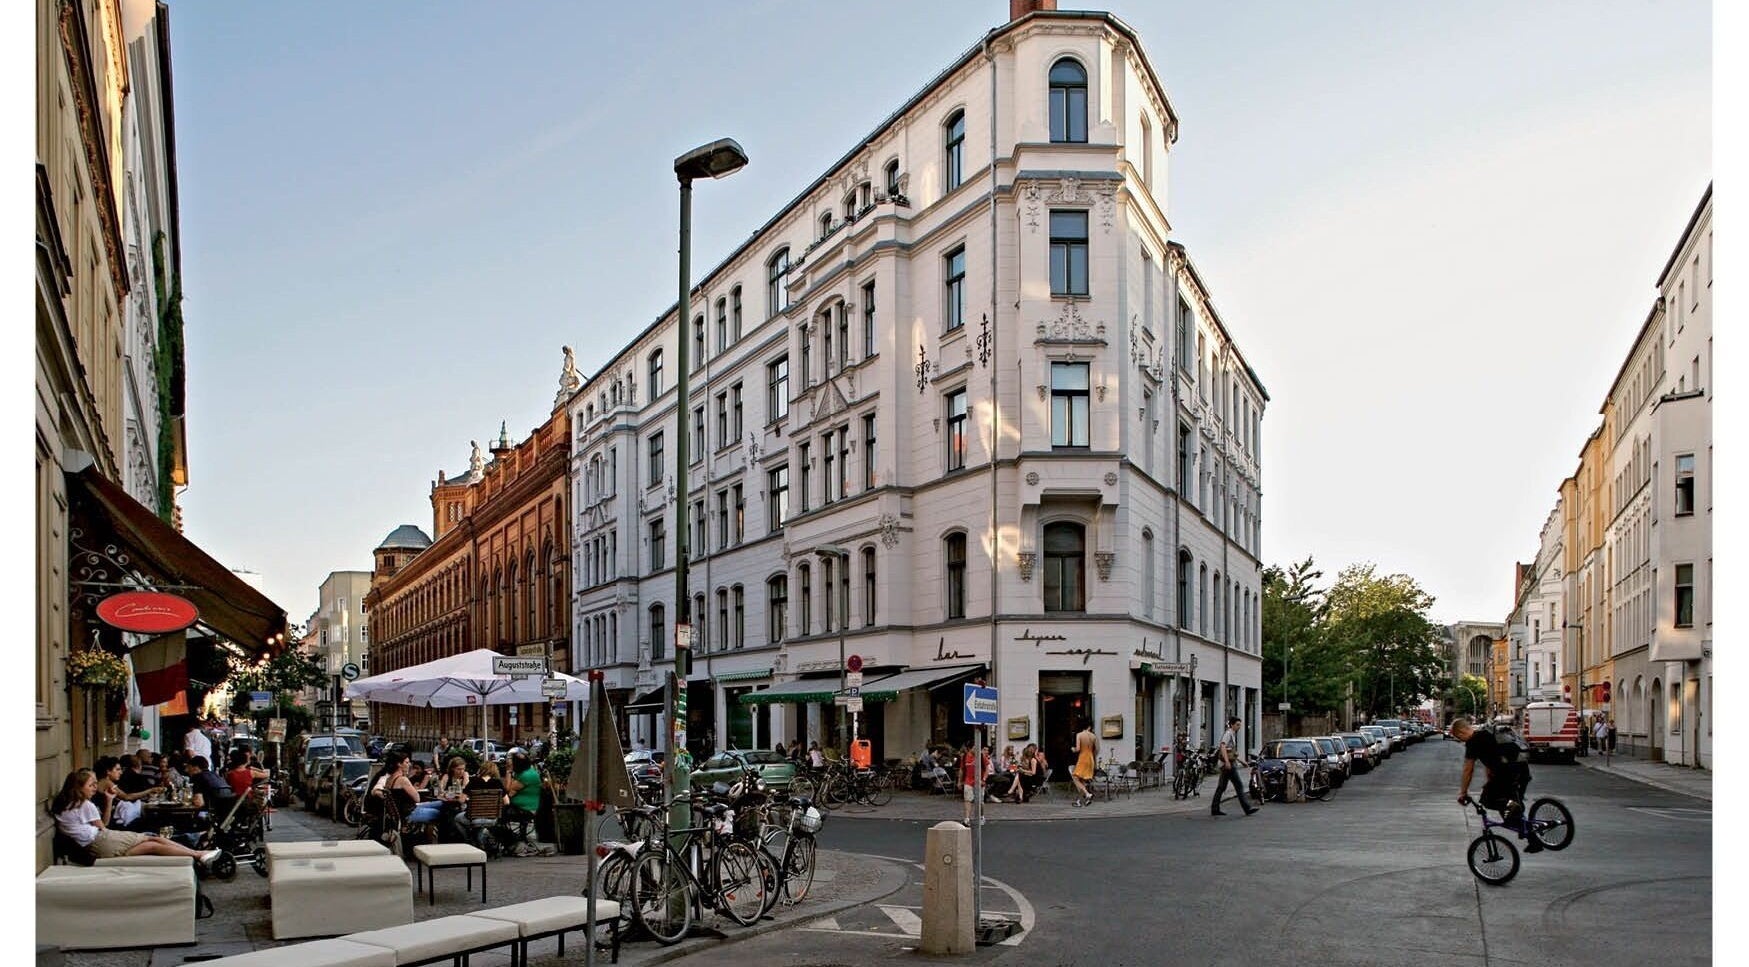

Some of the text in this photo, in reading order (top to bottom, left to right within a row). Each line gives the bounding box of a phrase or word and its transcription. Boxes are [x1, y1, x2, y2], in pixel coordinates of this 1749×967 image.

[932, 637, 976, 661] bar
[344, 664, 358, 679] S
[498, 660, 541, 671] Auguststraße
